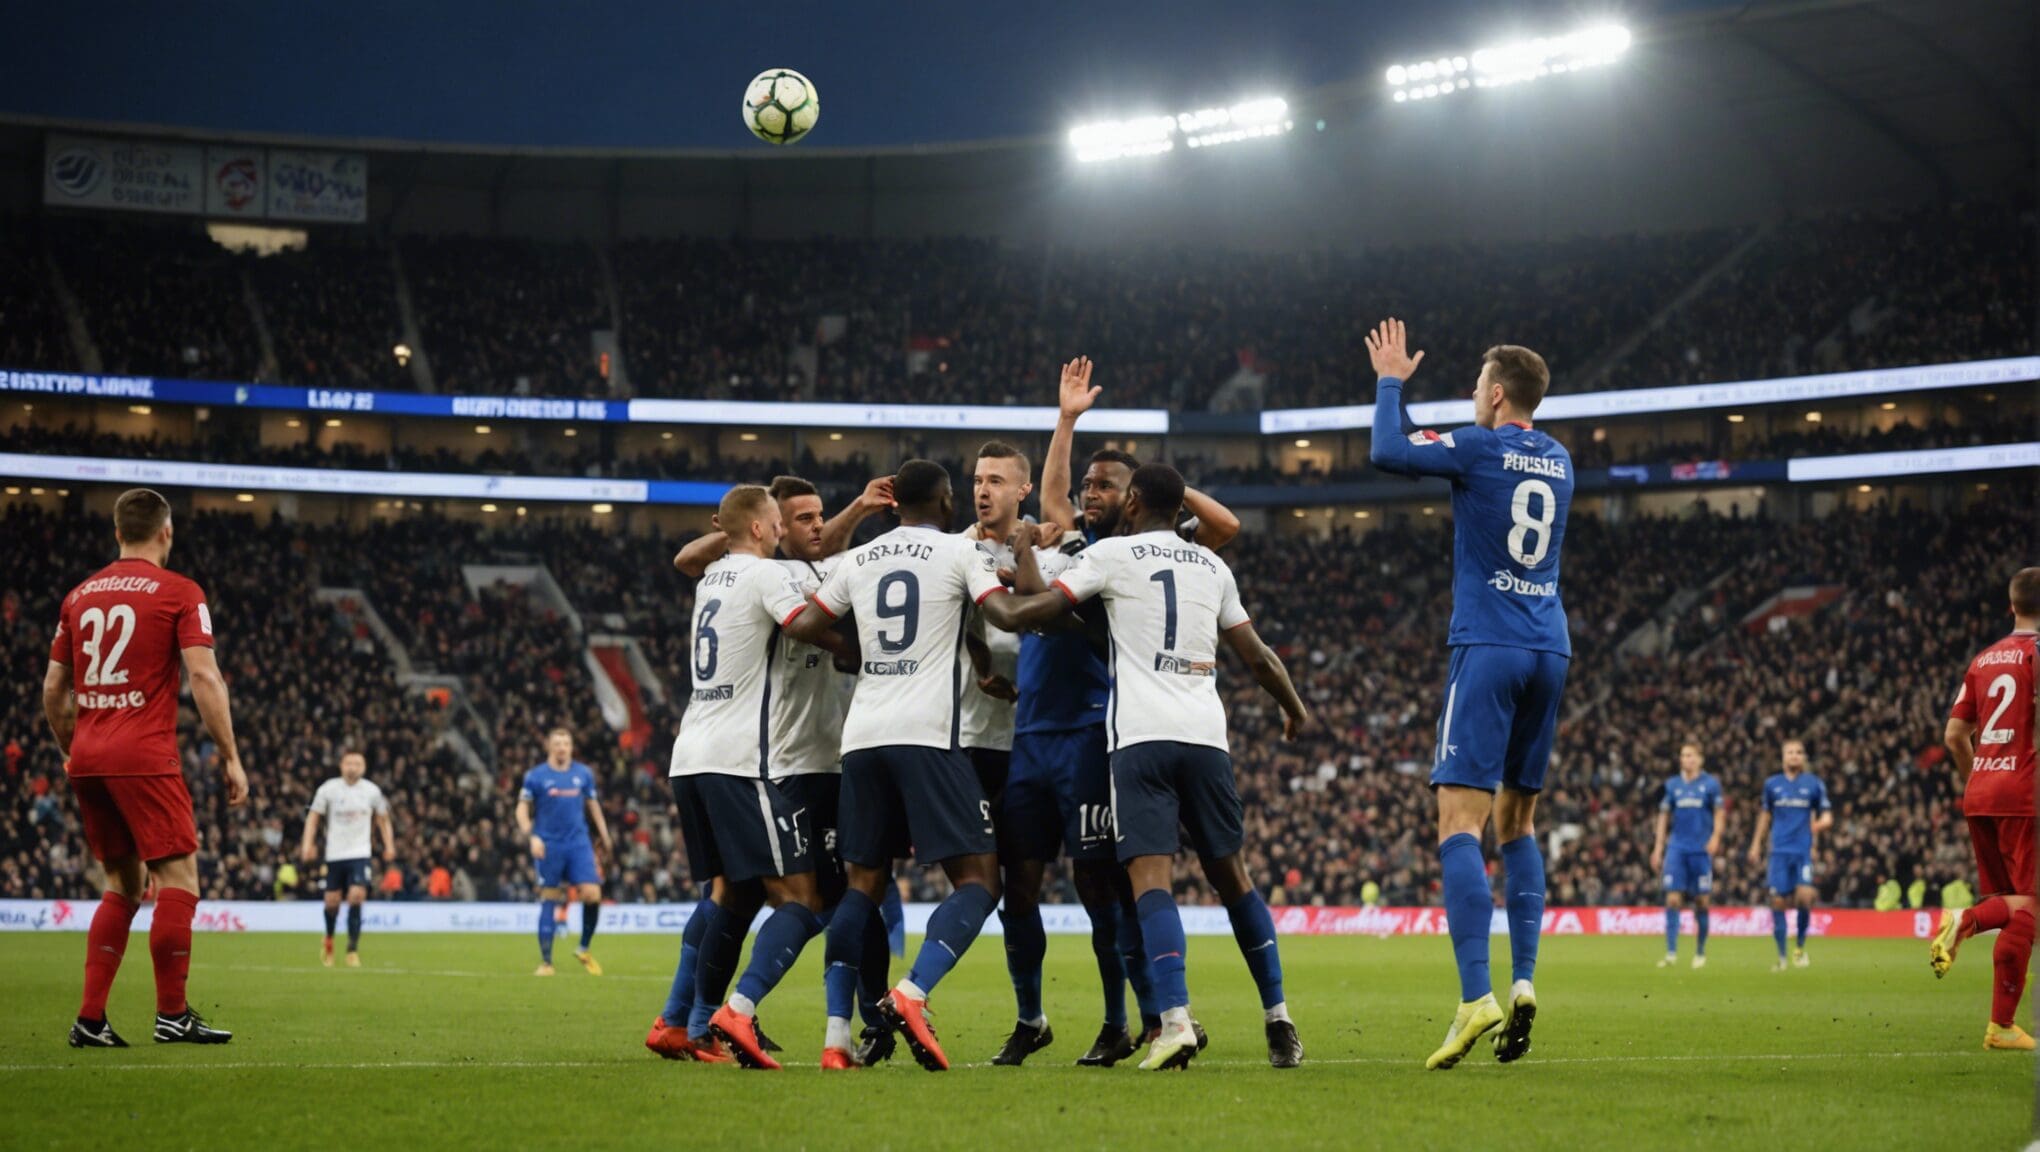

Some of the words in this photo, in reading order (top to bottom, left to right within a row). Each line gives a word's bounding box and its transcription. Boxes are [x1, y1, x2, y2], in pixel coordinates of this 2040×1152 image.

[1508, 479, 1556, 568] 8
[80, 604, 136, 686] 32
[876, 569, 920, 653] 9
[1150, 569, 1178, 652] 1
[1980, 673, 2017, 745] 2
